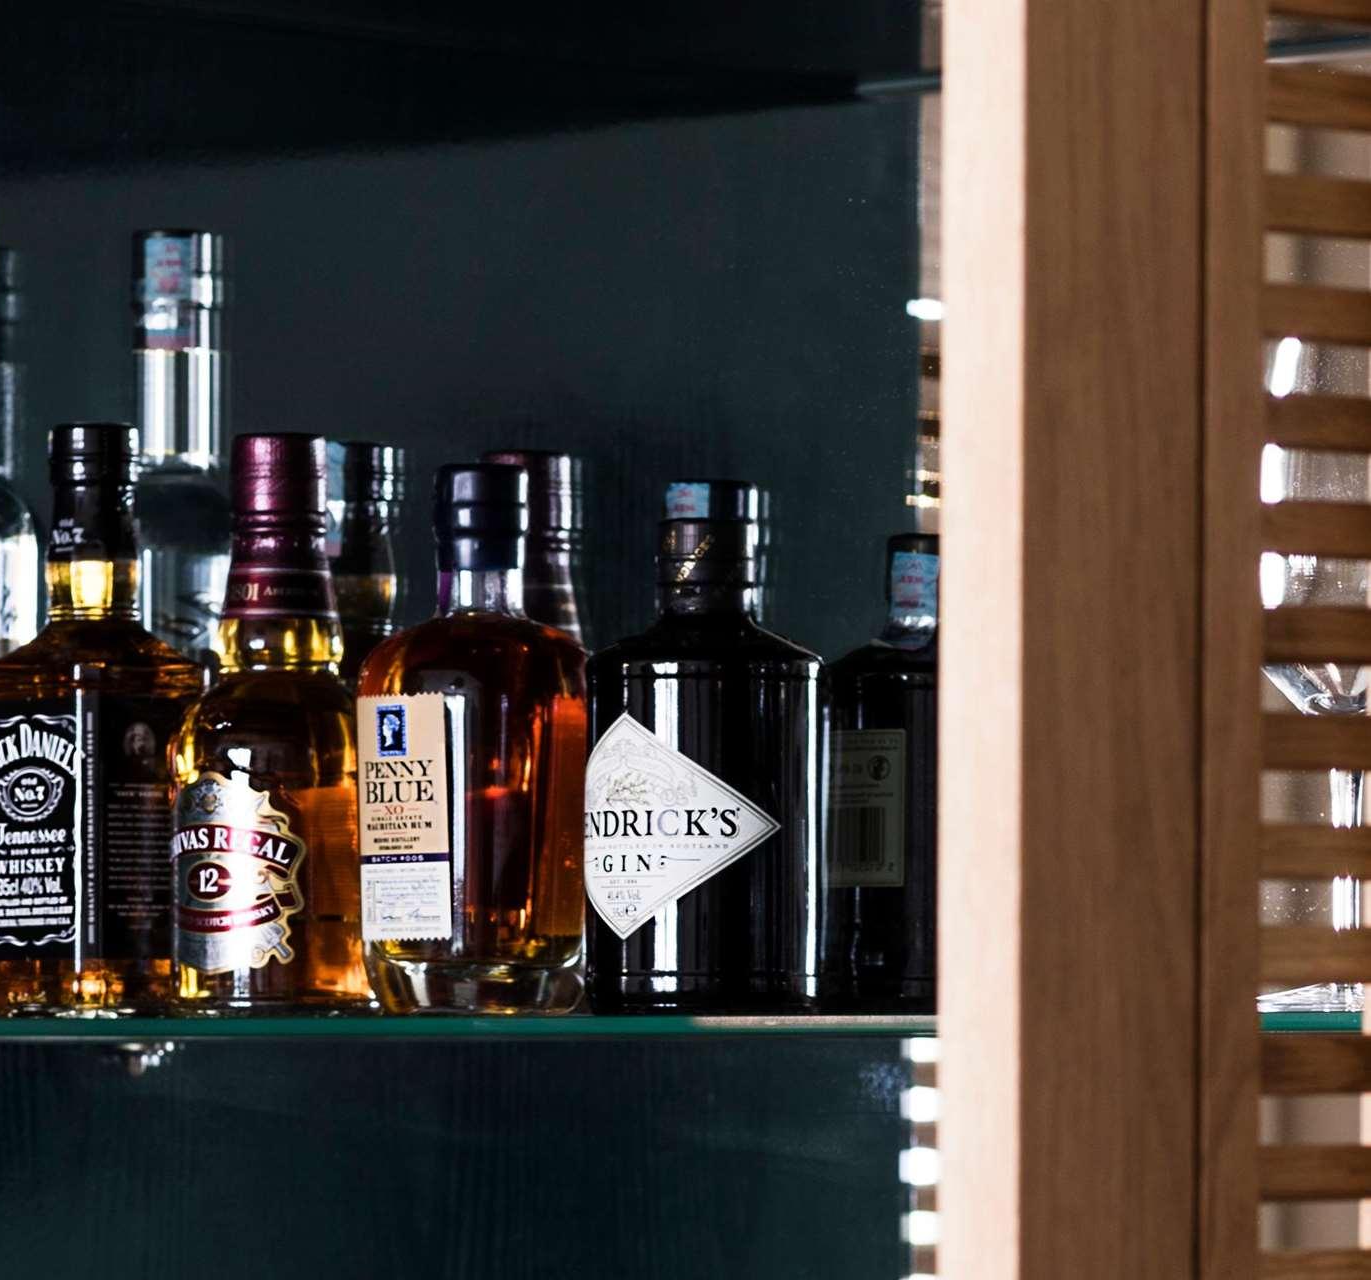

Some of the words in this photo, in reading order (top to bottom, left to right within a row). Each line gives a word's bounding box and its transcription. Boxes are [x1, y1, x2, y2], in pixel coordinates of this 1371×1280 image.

[20, 723, 86, 779] DANIELS
[365, 760, 434, 780] PENNY
[366, 780, 435, 805] BLUE
[384, 804, 405, 816] XO
[411, 820, 432, 829] RUM
[585, 807, 738, 838] ENDRICK'S
[602, 853, 652, 873] GIN
[199, 867, 220, 893] 12
